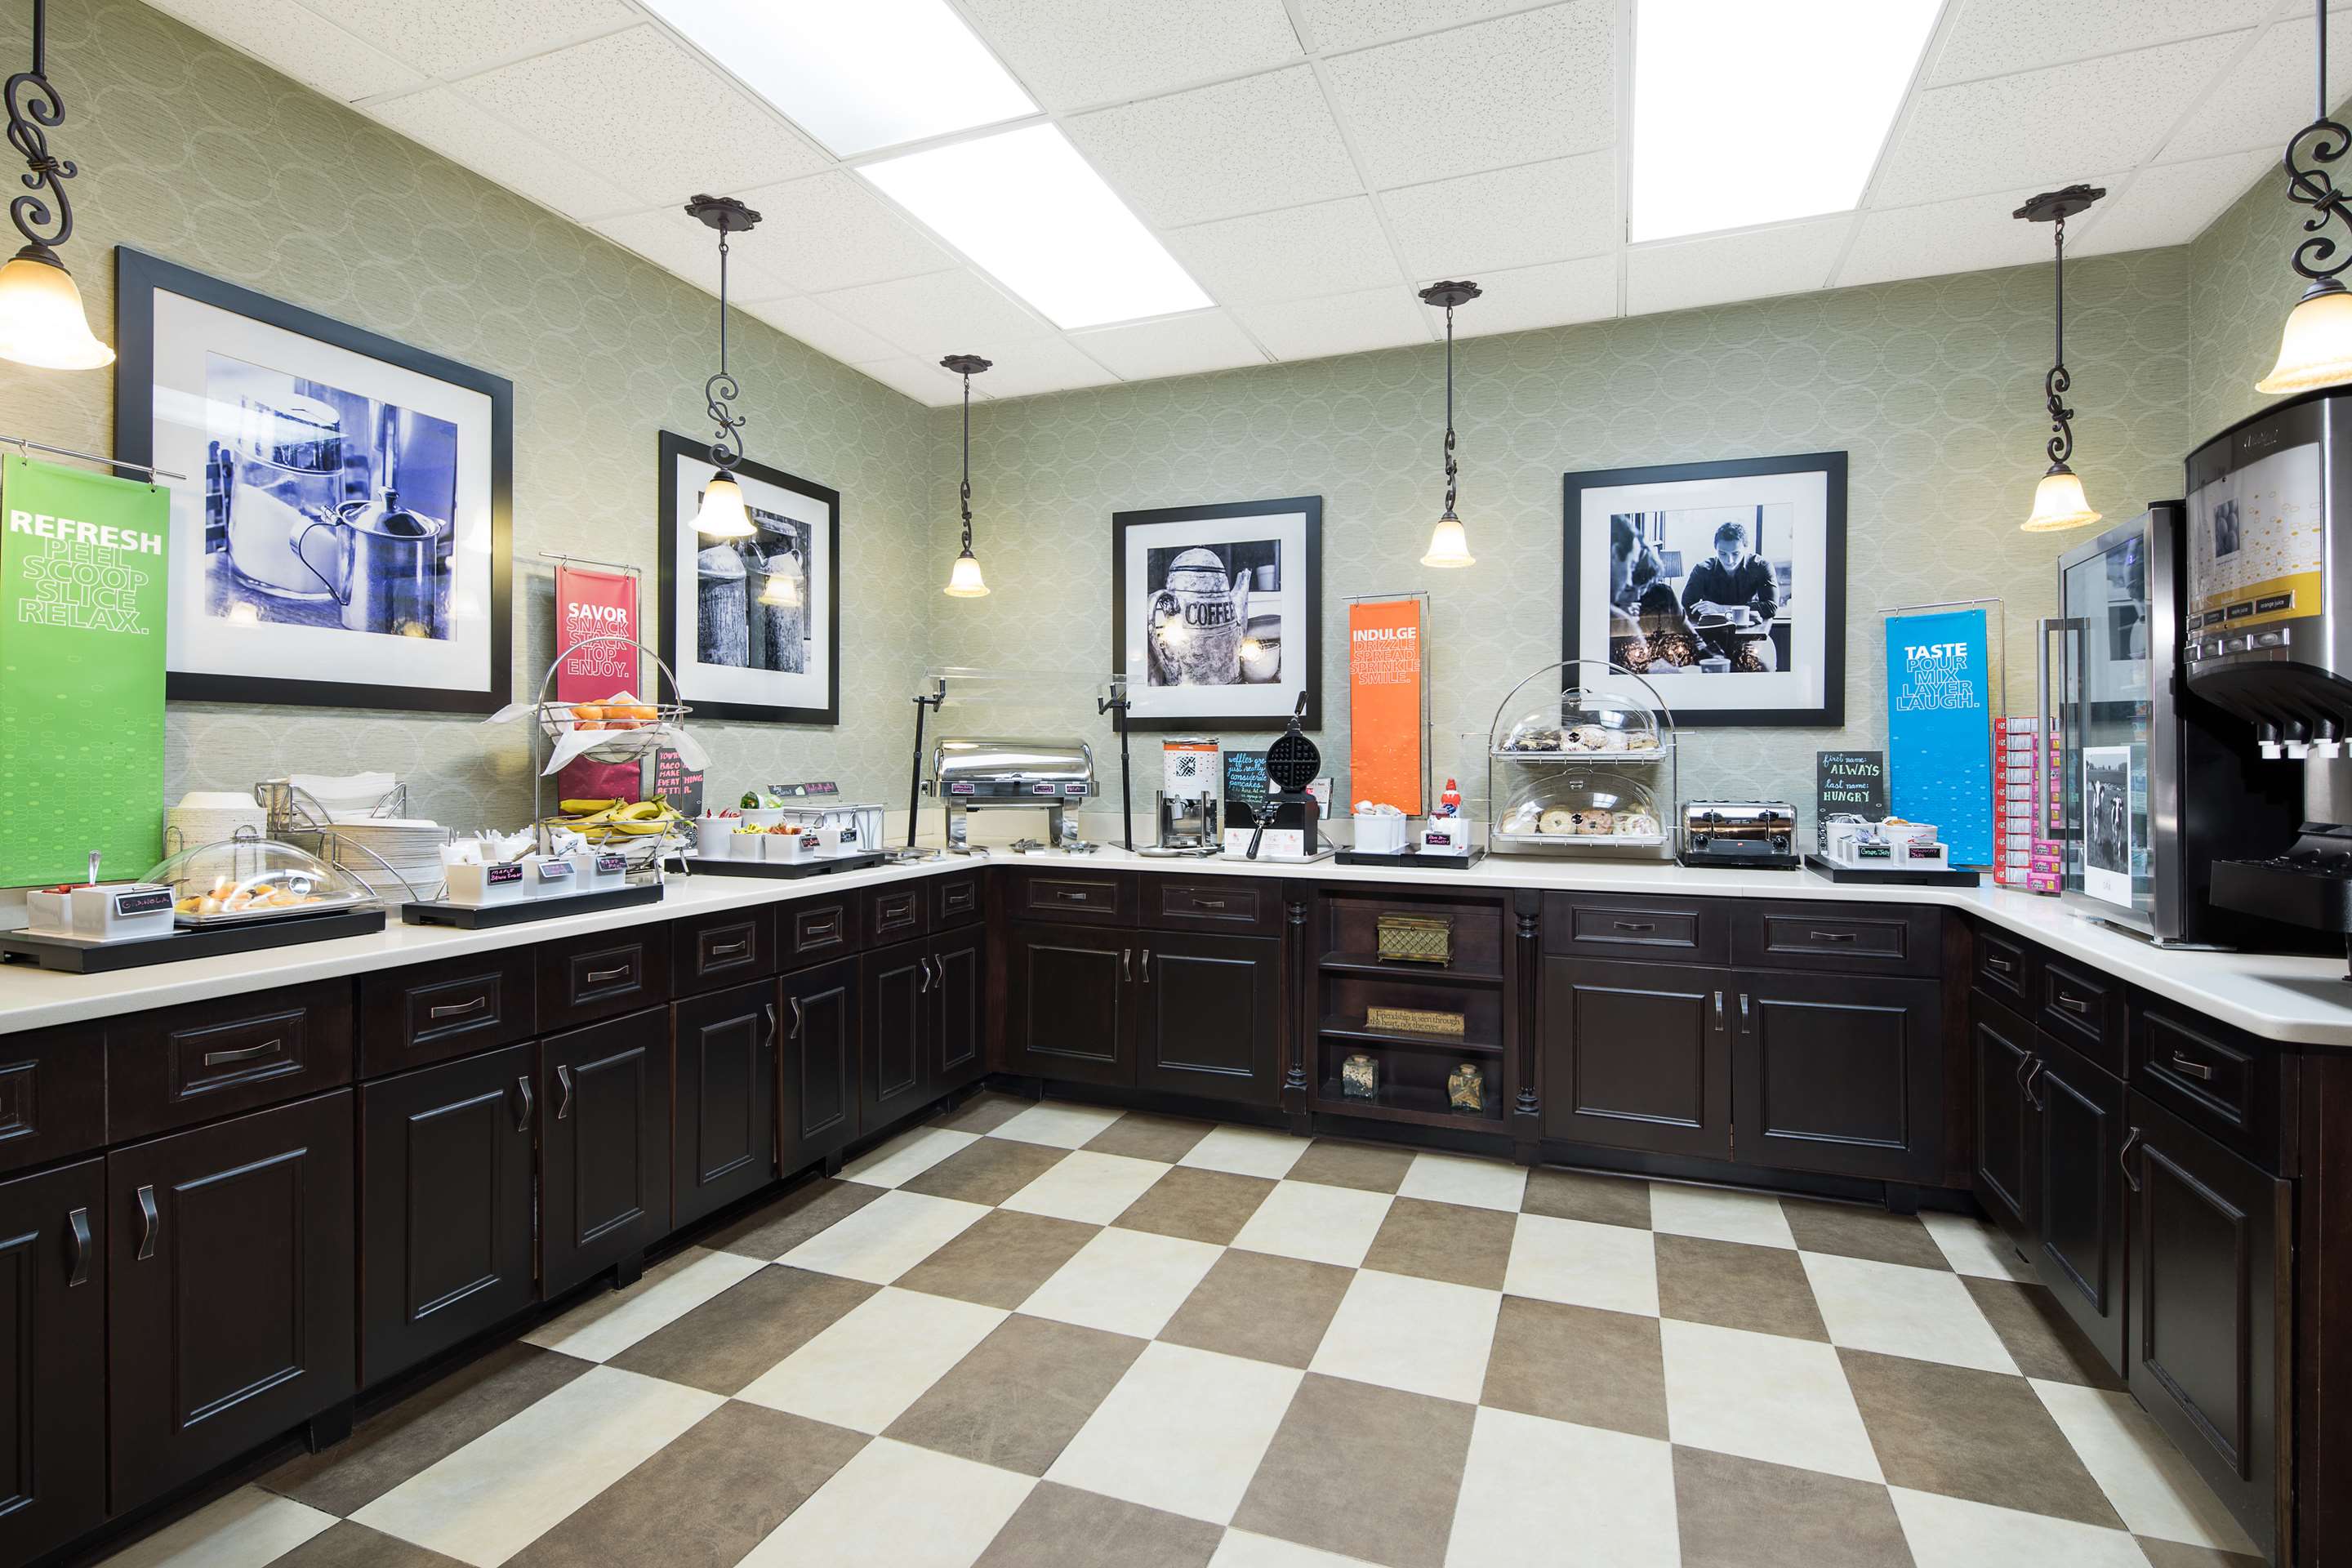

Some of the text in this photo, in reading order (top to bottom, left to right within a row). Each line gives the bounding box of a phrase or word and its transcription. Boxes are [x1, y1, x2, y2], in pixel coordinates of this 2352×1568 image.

[10, 509, 163, 555] REFRESH
[45, 536, 130, 570] PEEL
[23, 555, 149, 592] SCOOP
[35, 578, 137, 613] SLICE
[18, 599, 149, 635] RELAX.
[568, 603, 627, 622] SAVOR
[1185, 601, 1236, 626] COFFEE
[567, 617, 628, 637] SNACK
[1352, 627, 1417, 641] INDULGE
[569, 630, 627, 651] STACK
[1355, 639, 1416, 652] DRIZZLE
[581, 646, 617, 663] TOP
[1354, 649, 1415, 662] SPREAD
[1904, 643, 1967, 659] TASTE
[567, 659, 630, 678] ENJOY.
[1350, 659, 1421, 674] SPRINKLE
[1906, 655, 1967, 673] POUR
[1358, 671, 1411, 685] SMILE.
[1914, 668, 1959, 684] MIX
[1902, 680, 1973, 697] LAYER
[1896, 693, 1980, 710] LAUGH.
[1228, 753, 1254, 767] waffles
[1823, 753, 1844, 768] first
[1227, 763, 1266, 777] just really
[1230, 772, 1267, 782] considerate
[1830, 764, 1880, 776] ALWAYS
[1824, 778, 1844, 789] last
[1824, 791, 1869, 802] HUNGRY
[1370, 1017, 1381, 1025] the
[1412, 1021, 1424, 1029] the
[1375, 1010, 1410, 1022] Friendship
[1432, 1015, 1460, 1027] through
